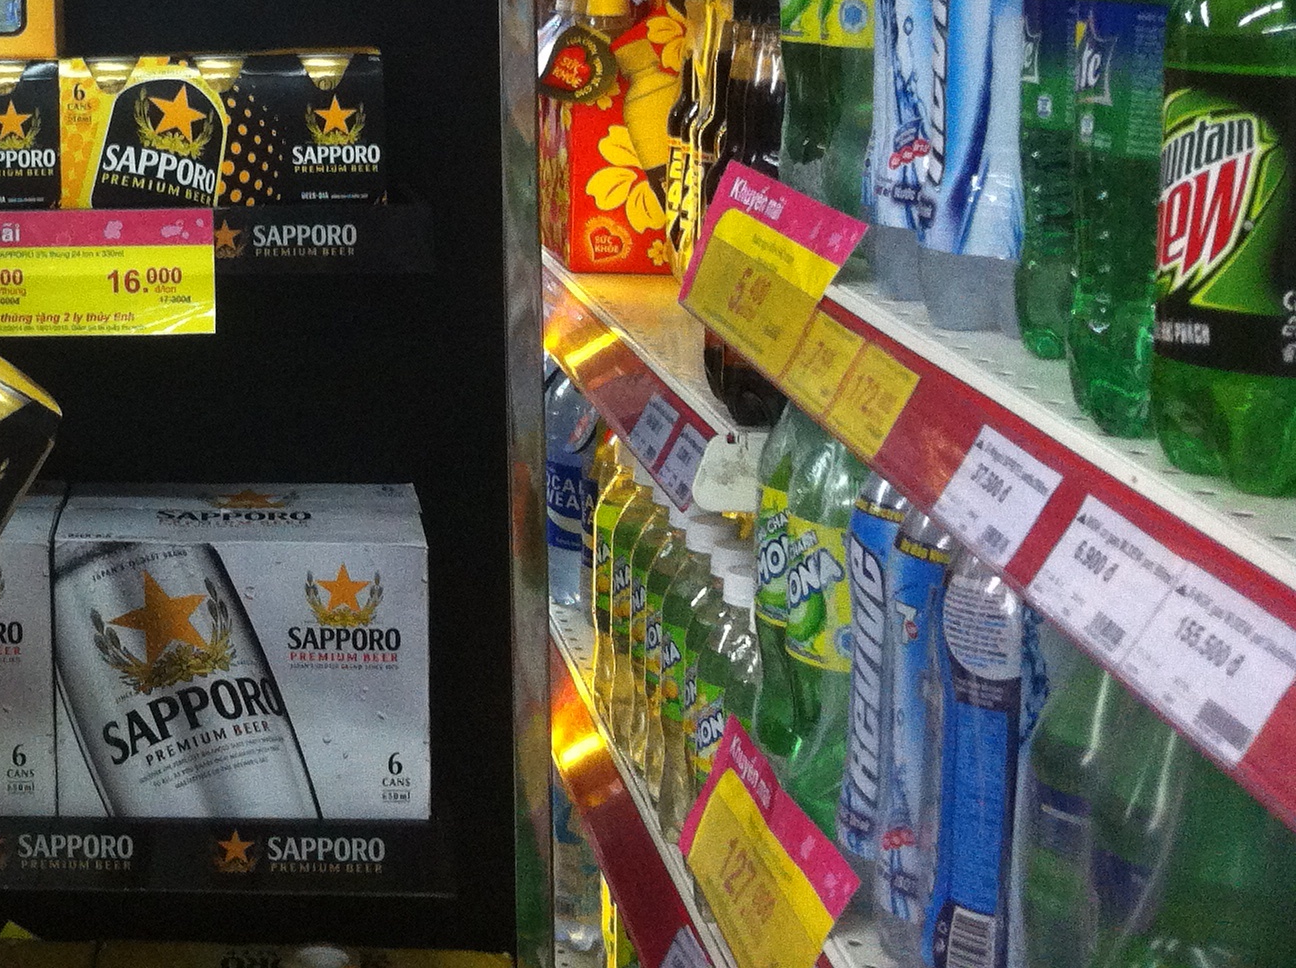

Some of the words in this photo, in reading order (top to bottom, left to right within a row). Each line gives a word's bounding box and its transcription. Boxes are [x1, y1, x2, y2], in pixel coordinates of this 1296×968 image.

[73, 83, 86, 101] 6
[292, 144, 381, 165] SAPPORO
[1161, 116, 1256, 187] untain
[23, 167, 54, 177] BEER
[103, 144, 216, 193] SAPPORO
[294, 164, 347, 173] PREMIUM
[351, 163, 379, 172] BEER
[102, 172, 181, 199] PREMIUM
[185, 187, 215, 206] BEER
[254, 224, 357, 247] SAPPORO
[255, 248, 317, 257] PREMIUM
[323, 247, 355, 257] BEER
[0, 312, 33, 325] thùng
[63, 312, 71, 322] 2
[72, 311, 83, 324] ly
[157, 510, 312, 522] SAPPORO
[288, 626, 401, 651] SAPPORO
[290, 652, 357, 662] PREMIUM
[363, 652, 398, 662] BEER
[104, 676, 286, 765] SAPPORO
[145, 727, 228, 767] PREMIUM
[231, 719, 271, 736] BEER
[12, 744, 27, 767] 6
[387, 752, 403, 775] 6
[6, 767, 35, 778] CANS
[382, 777, 411, 787] CANS
[18, 834, 134, 860] SAPPORO
[267, 836, 386, 863] SAPPORO
